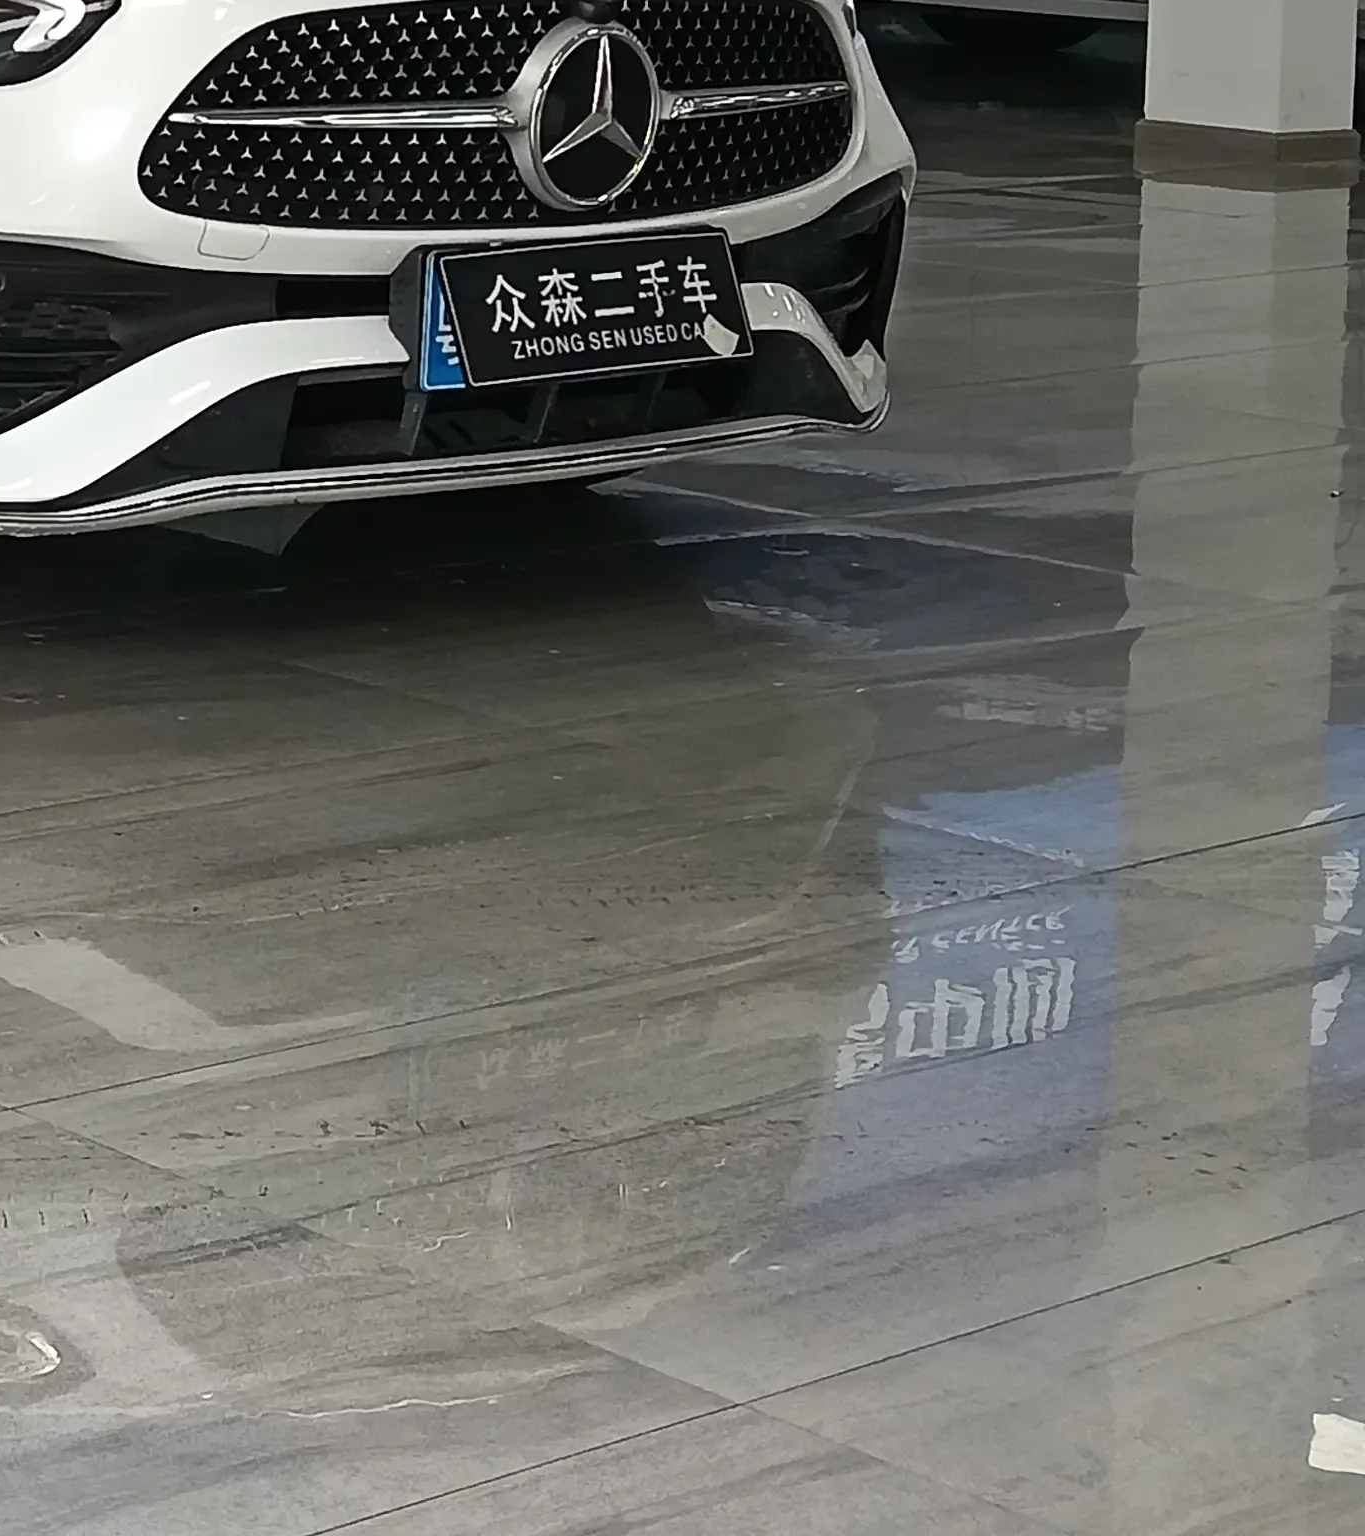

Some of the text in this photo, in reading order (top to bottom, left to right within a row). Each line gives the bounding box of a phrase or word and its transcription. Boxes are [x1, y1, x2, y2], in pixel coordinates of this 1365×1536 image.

[485, 255, 718, 334] 众森二手车
[510, 321, 709, 360] ZHONG SEN USED CA
